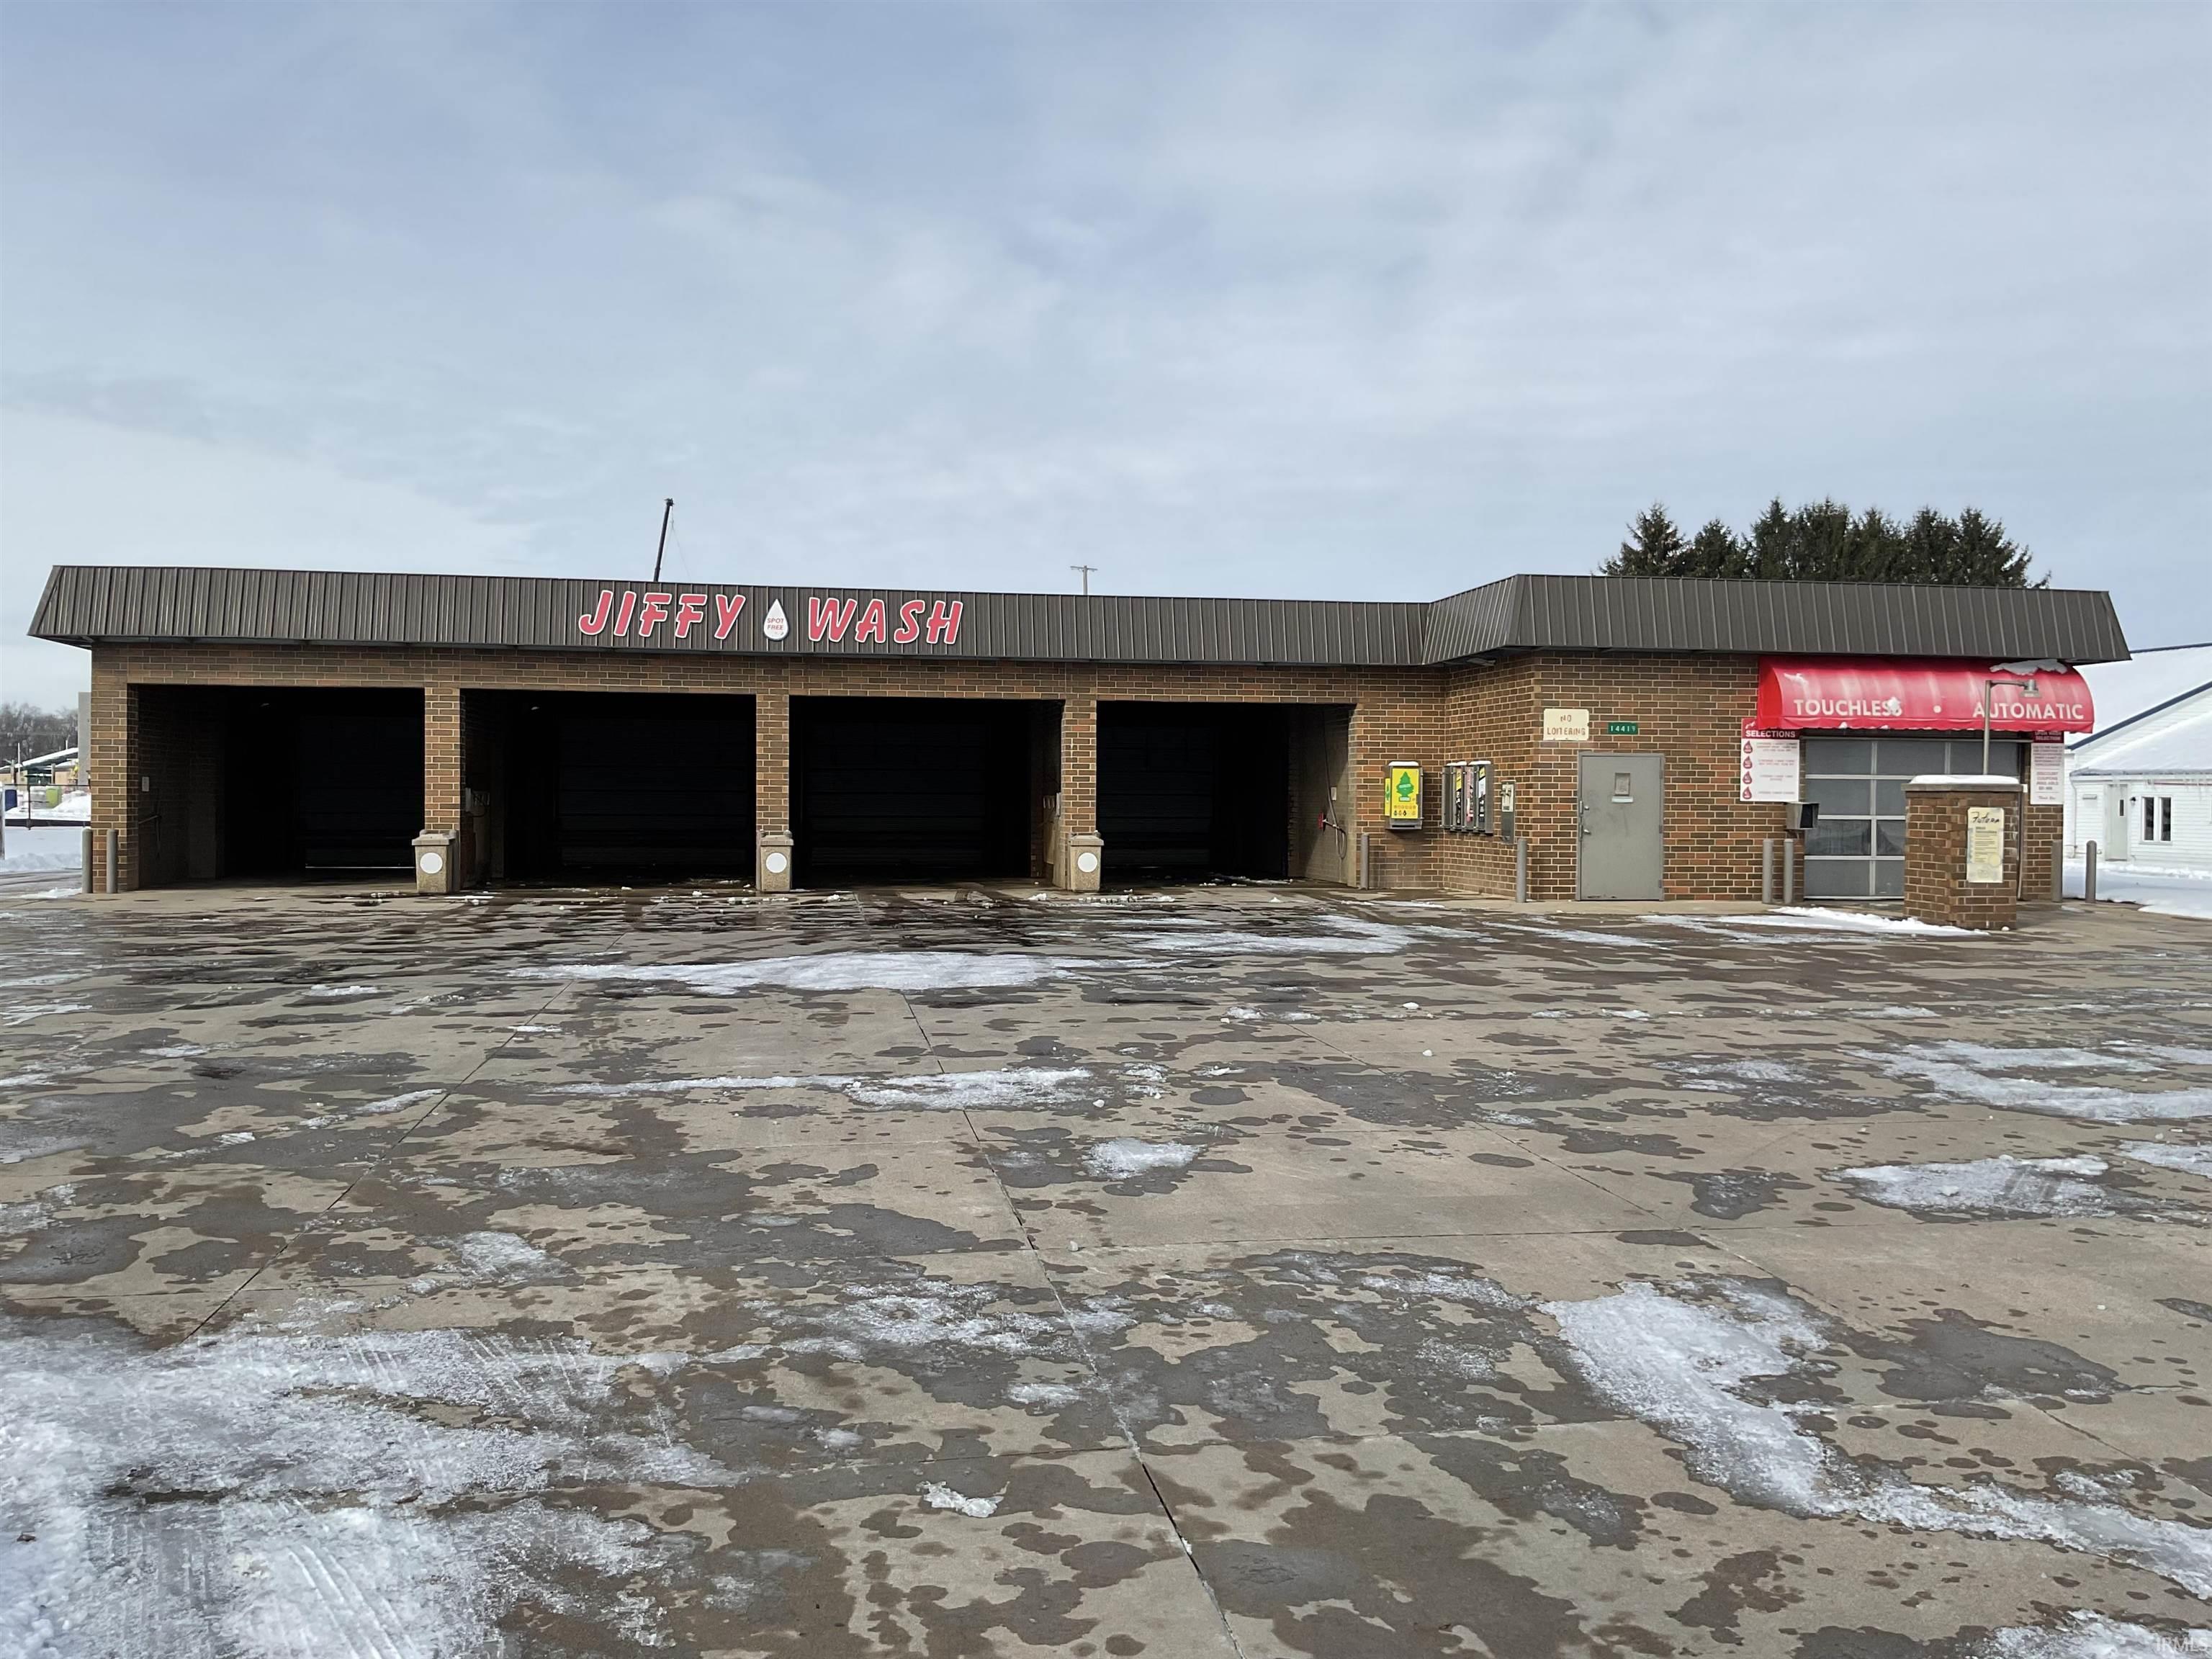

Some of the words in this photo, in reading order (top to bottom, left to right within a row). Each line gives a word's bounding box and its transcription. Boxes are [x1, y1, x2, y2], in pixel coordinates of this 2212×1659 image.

[578, 590, 746, 639] JIFFY
[809, 597, 963, 644] WASH
[1972, 702, 2084, 719] AUTOMATIC
[1547, 727, 1586, 736] LOITERING
